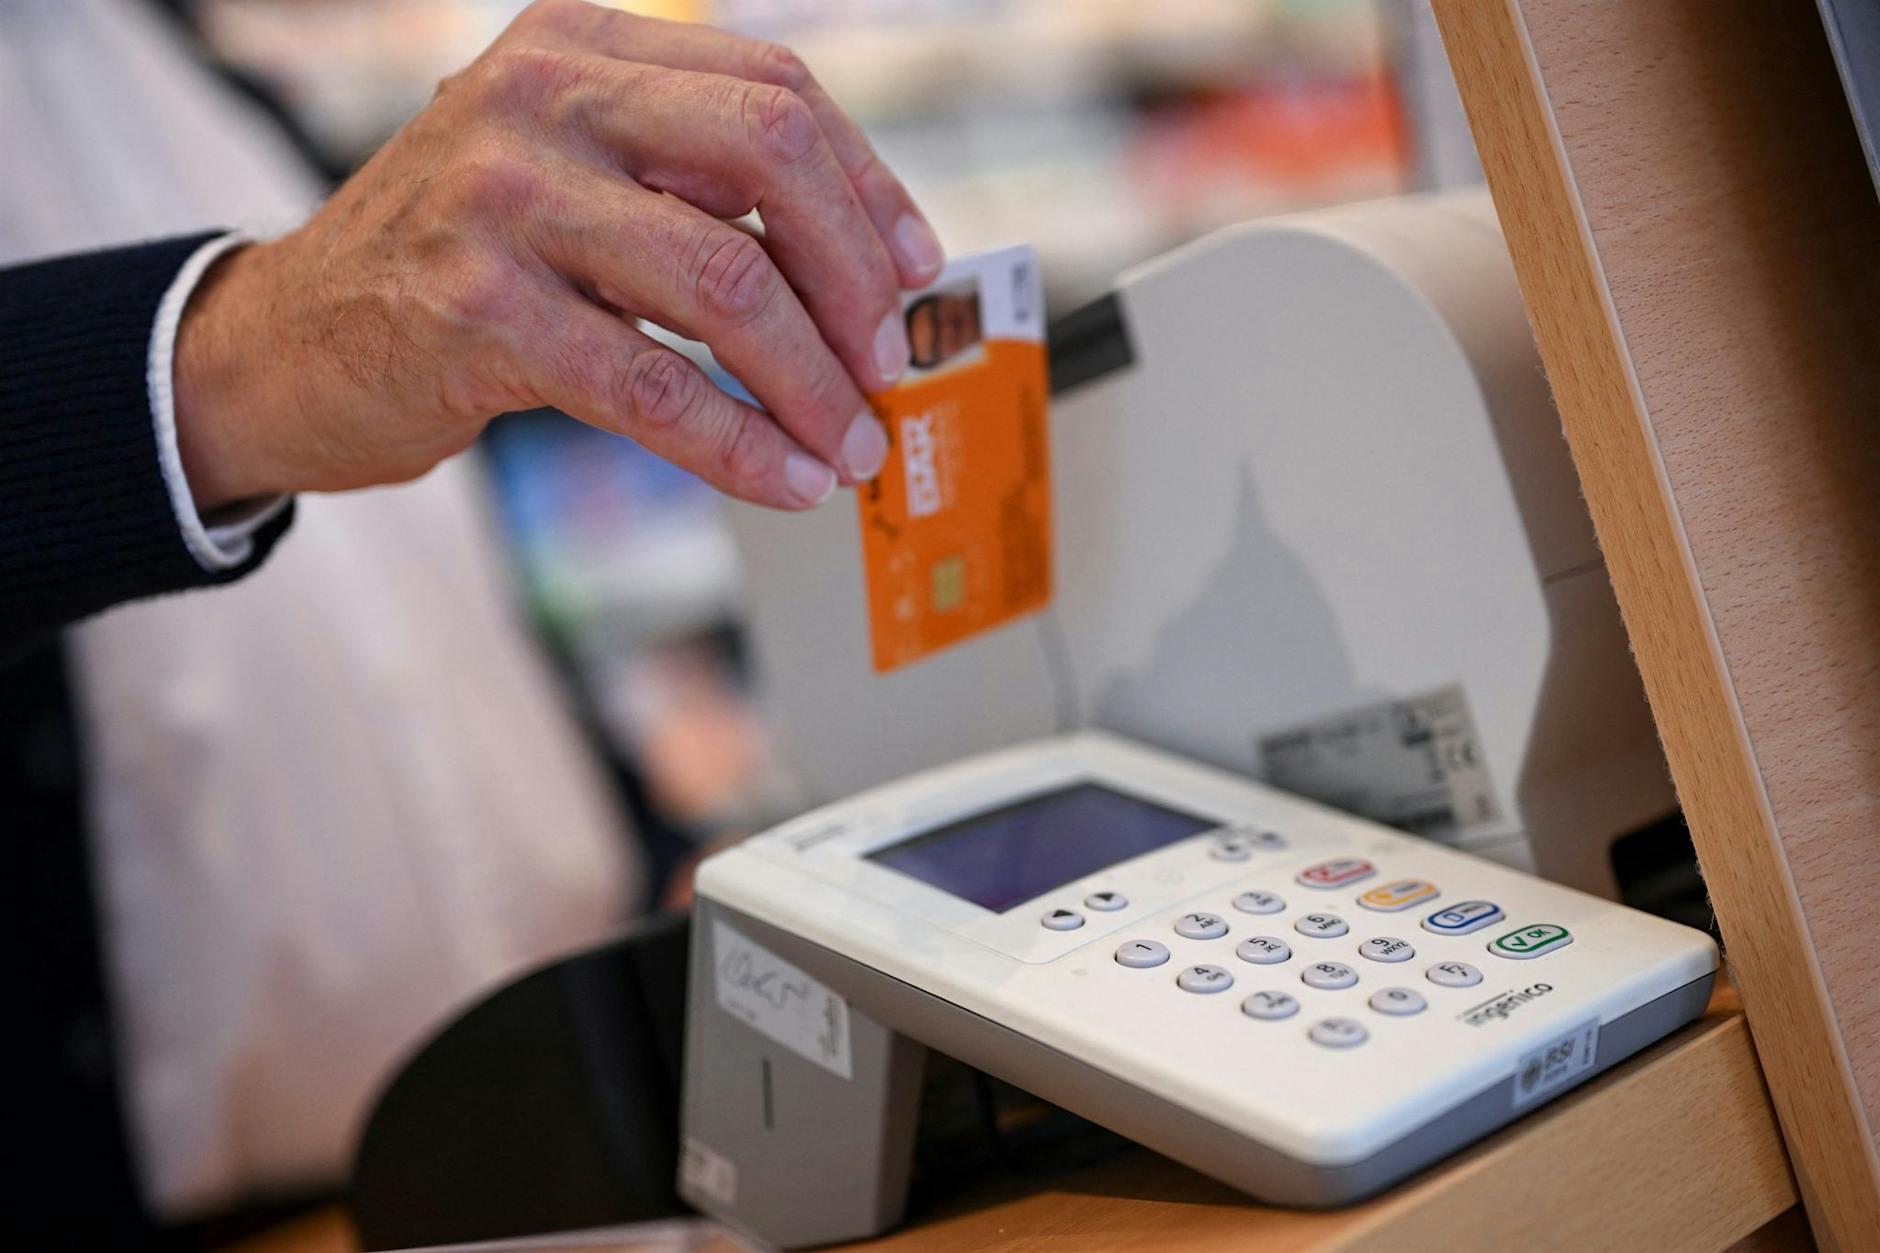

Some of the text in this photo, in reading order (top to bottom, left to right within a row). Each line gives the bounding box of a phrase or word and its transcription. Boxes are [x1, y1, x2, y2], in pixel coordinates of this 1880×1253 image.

[1186, 913, 1206, 923] 2
[1307, 914, 1325, 923] 6
[1527, 928, 1552, 939] OK
[1249, 937, 1268, 947] 5
[1371, 938, 1390, 947] 9
[1135, 943, 1153, 952] 1
[1193, 966, 1210, 976] 4
[1315, 964, 1336, 973] 8
[1458, 982, 1553, 1026] ingenico
